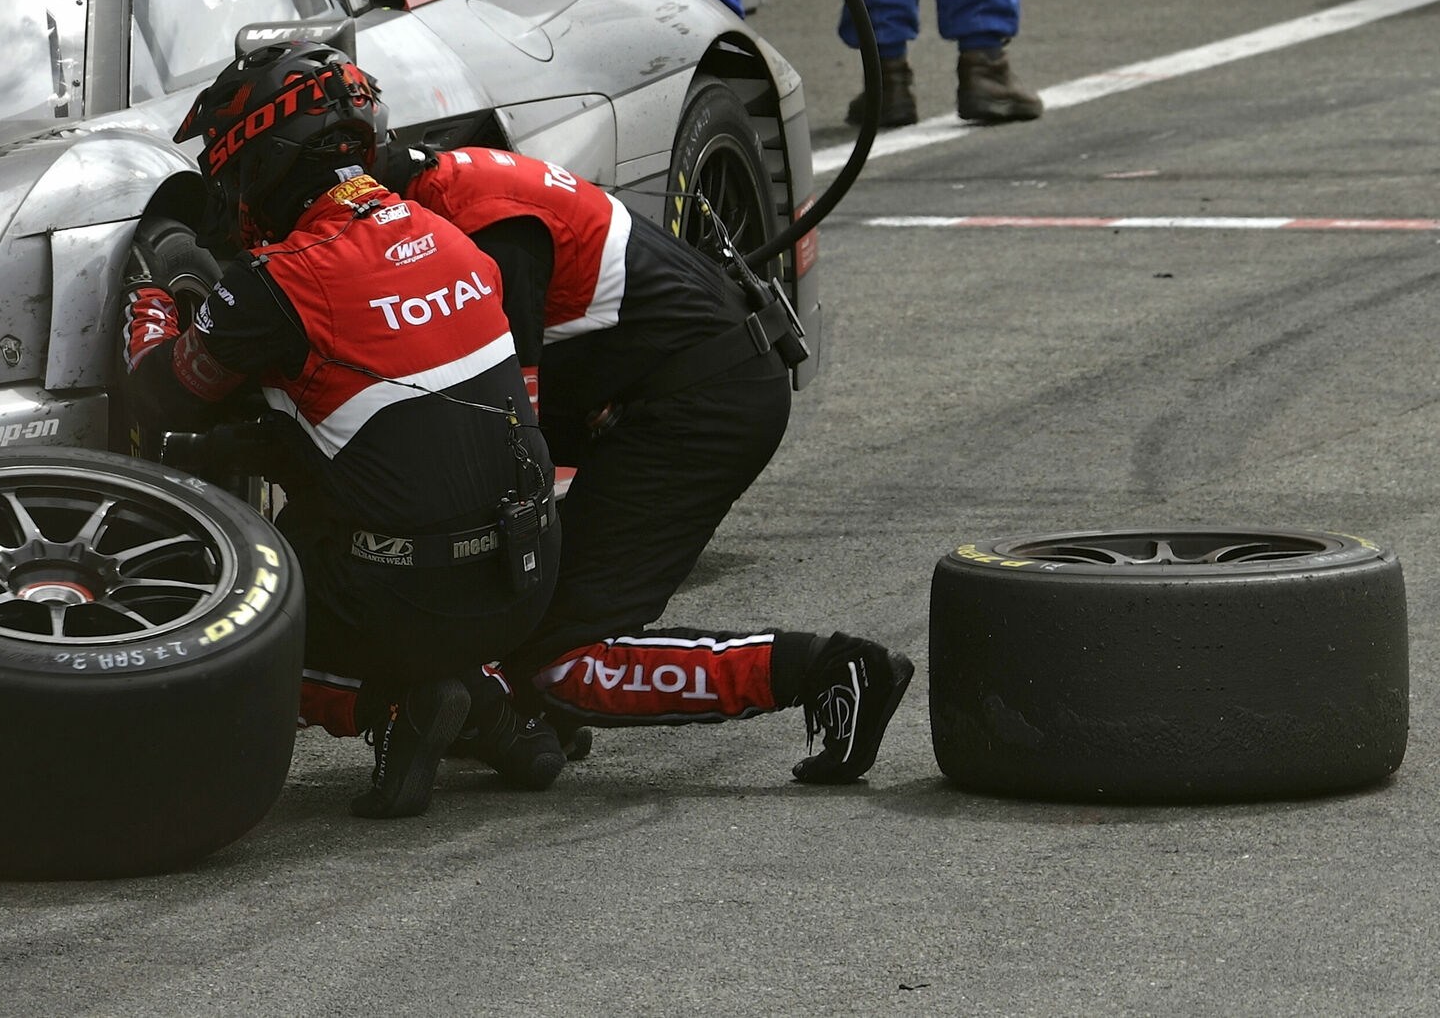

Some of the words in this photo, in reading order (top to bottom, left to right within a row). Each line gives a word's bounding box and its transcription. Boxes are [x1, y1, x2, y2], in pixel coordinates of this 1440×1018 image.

[209, 71, 333, 176] SCOTT
[396, 232, 434, 260] WRT
[369, 271, 492, 330] TOTAL
[255, 544, 279, 567] P
[203, 567, 279, 642] ZERO
[582, 655, 719, 701] TOTAL
